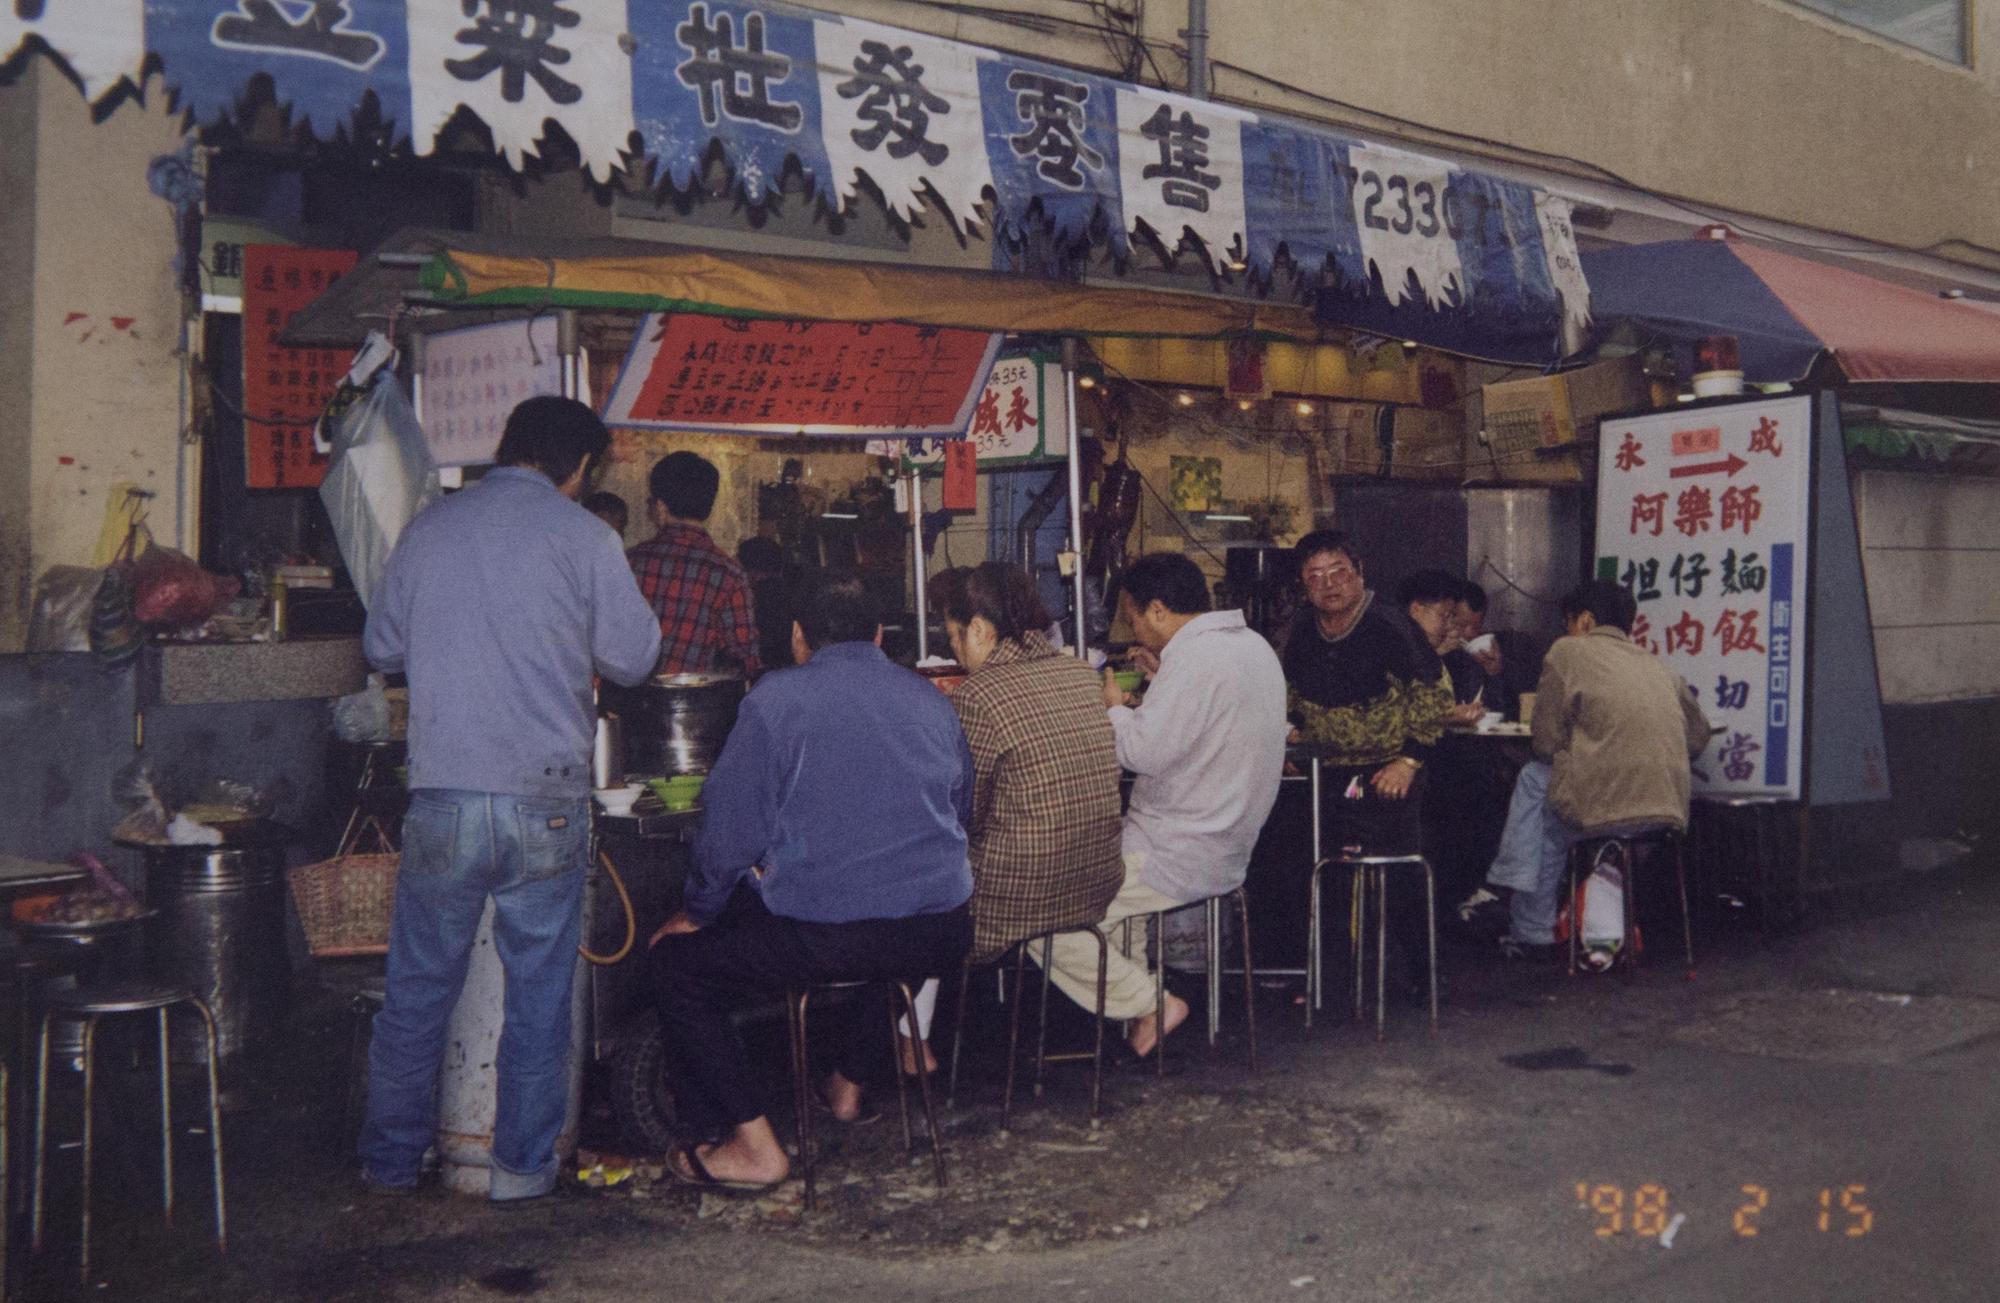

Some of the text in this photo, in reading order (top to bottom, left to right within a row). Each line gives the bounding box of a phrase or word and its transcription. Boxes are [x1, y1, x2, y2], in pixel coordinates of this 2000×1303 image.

[1614, 431, 1646, 472] 永
[1748, 416, 1783, 458] 成
[1630, 484, 1763, 537] 阿樂師
